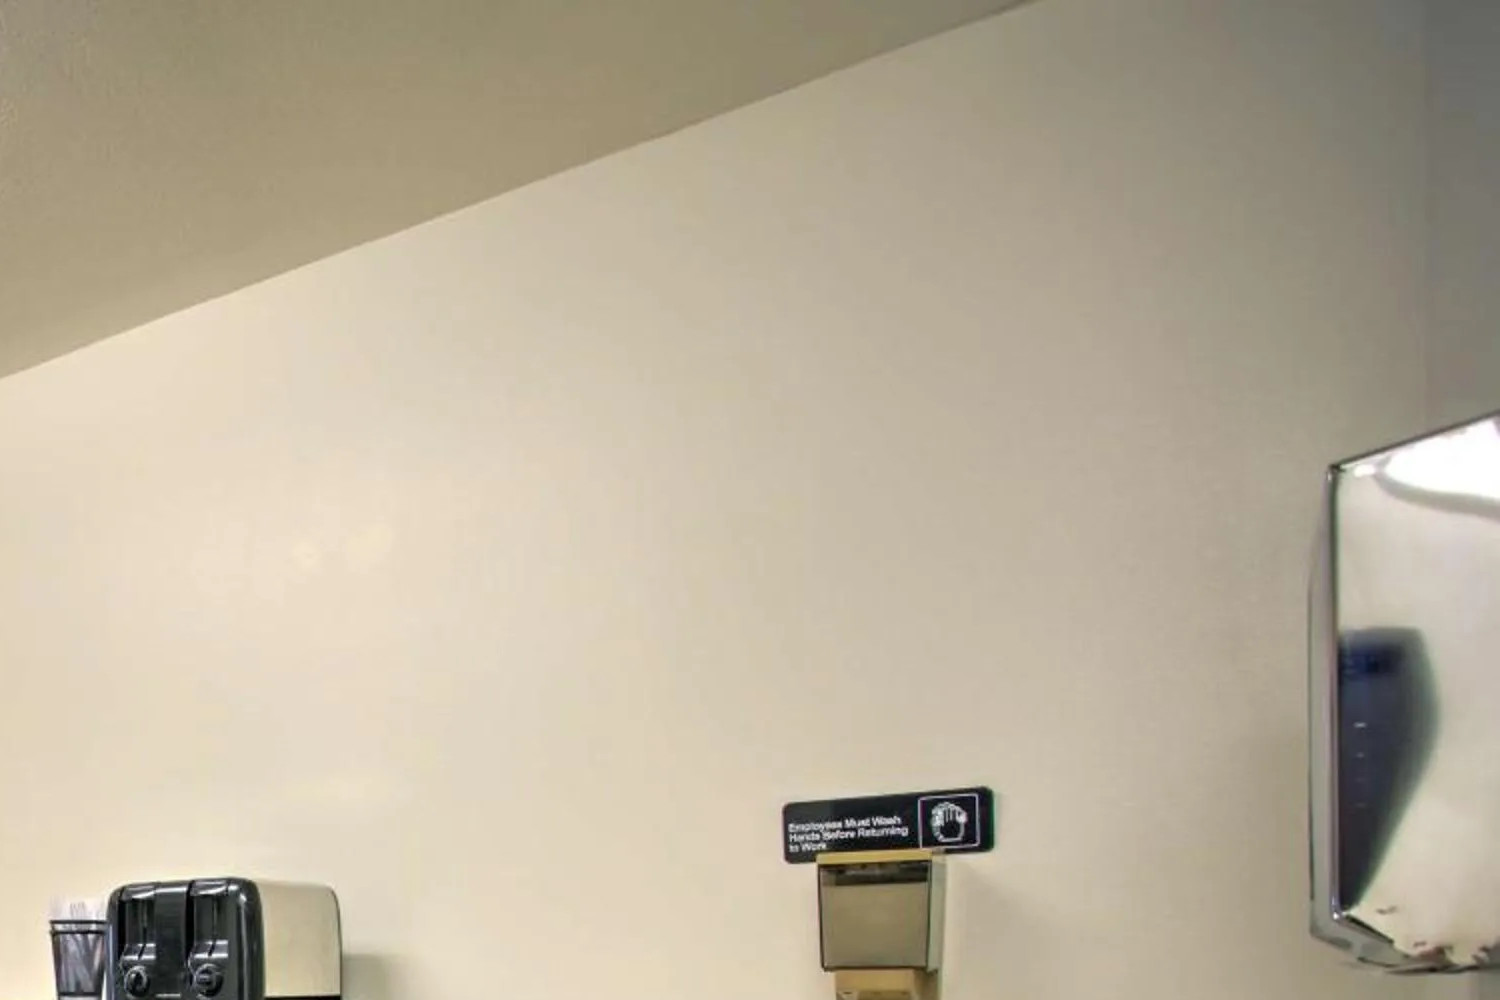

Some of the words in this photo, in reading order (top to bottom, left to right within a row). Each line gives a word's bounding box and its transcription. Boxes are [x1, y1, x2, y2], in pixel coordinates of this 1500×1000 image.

[788, 820, 843, 833] Employees
[844, 818, 870, 829] Must
[871, 815, 902, 826] Wash
[789, 832, 821, 843] Hands
[822, 830, 856, 841] Before
[857, 826, 909, 838] Returning
[789, 844, 800, 853] to
[801, 842, 827, 851] Work
